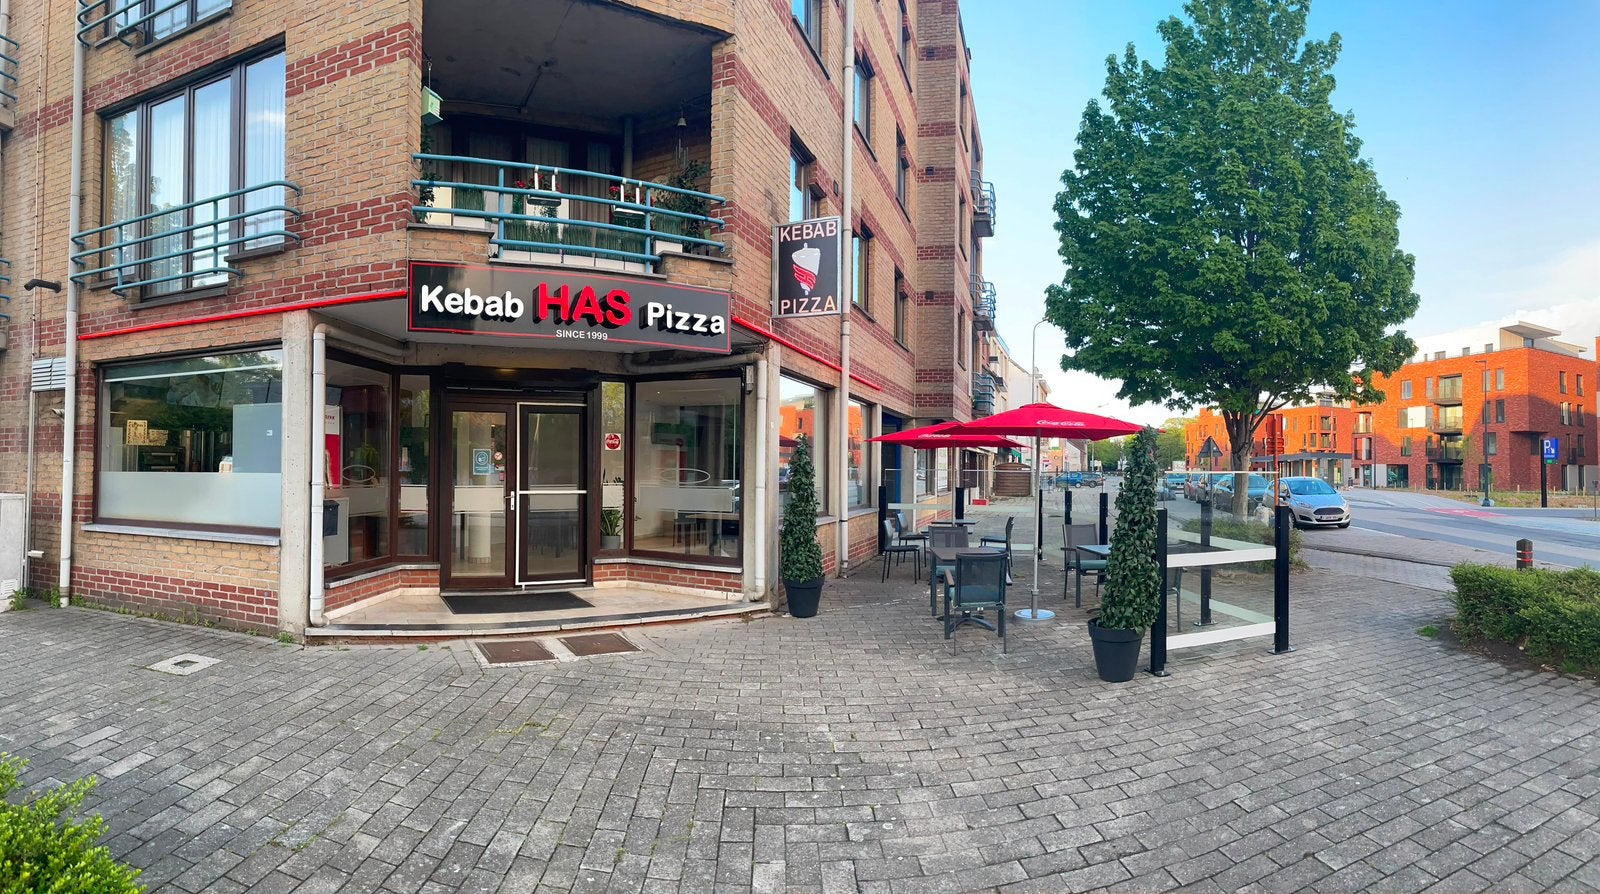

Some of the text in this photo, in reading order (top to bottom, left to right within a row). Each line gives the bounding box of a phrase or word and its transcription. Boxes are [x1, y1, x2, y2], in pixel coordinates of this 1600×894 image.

[780, 221, 837, 242] KEBAB
[421, 282, 726, 334] Kebab HAS Pizza
[780, 295, 836, 315] PIZZA
[555, 329, 608, 341] SINCE 1999
[1544, 440, 1551, 454] P
